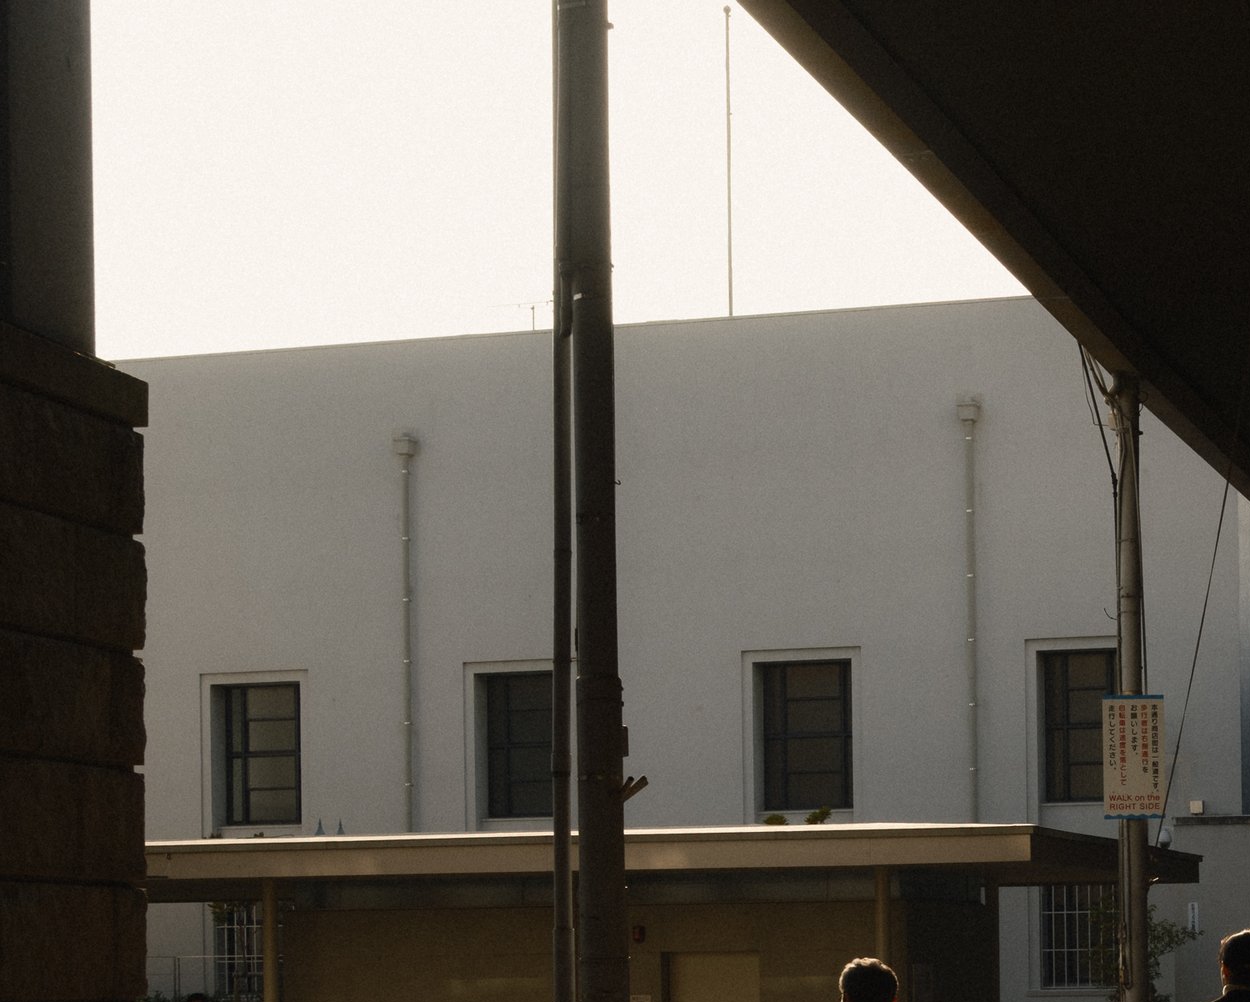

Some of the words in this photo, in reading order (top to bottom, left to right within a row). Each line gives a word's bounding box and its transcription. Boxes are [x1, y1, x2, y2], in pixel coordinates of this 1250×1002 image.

[1109, 794, 1133, 802] WALK
[1109, 802, 1137, 810] RIGHT
[1139, 802, 1160, 810] SIDE
